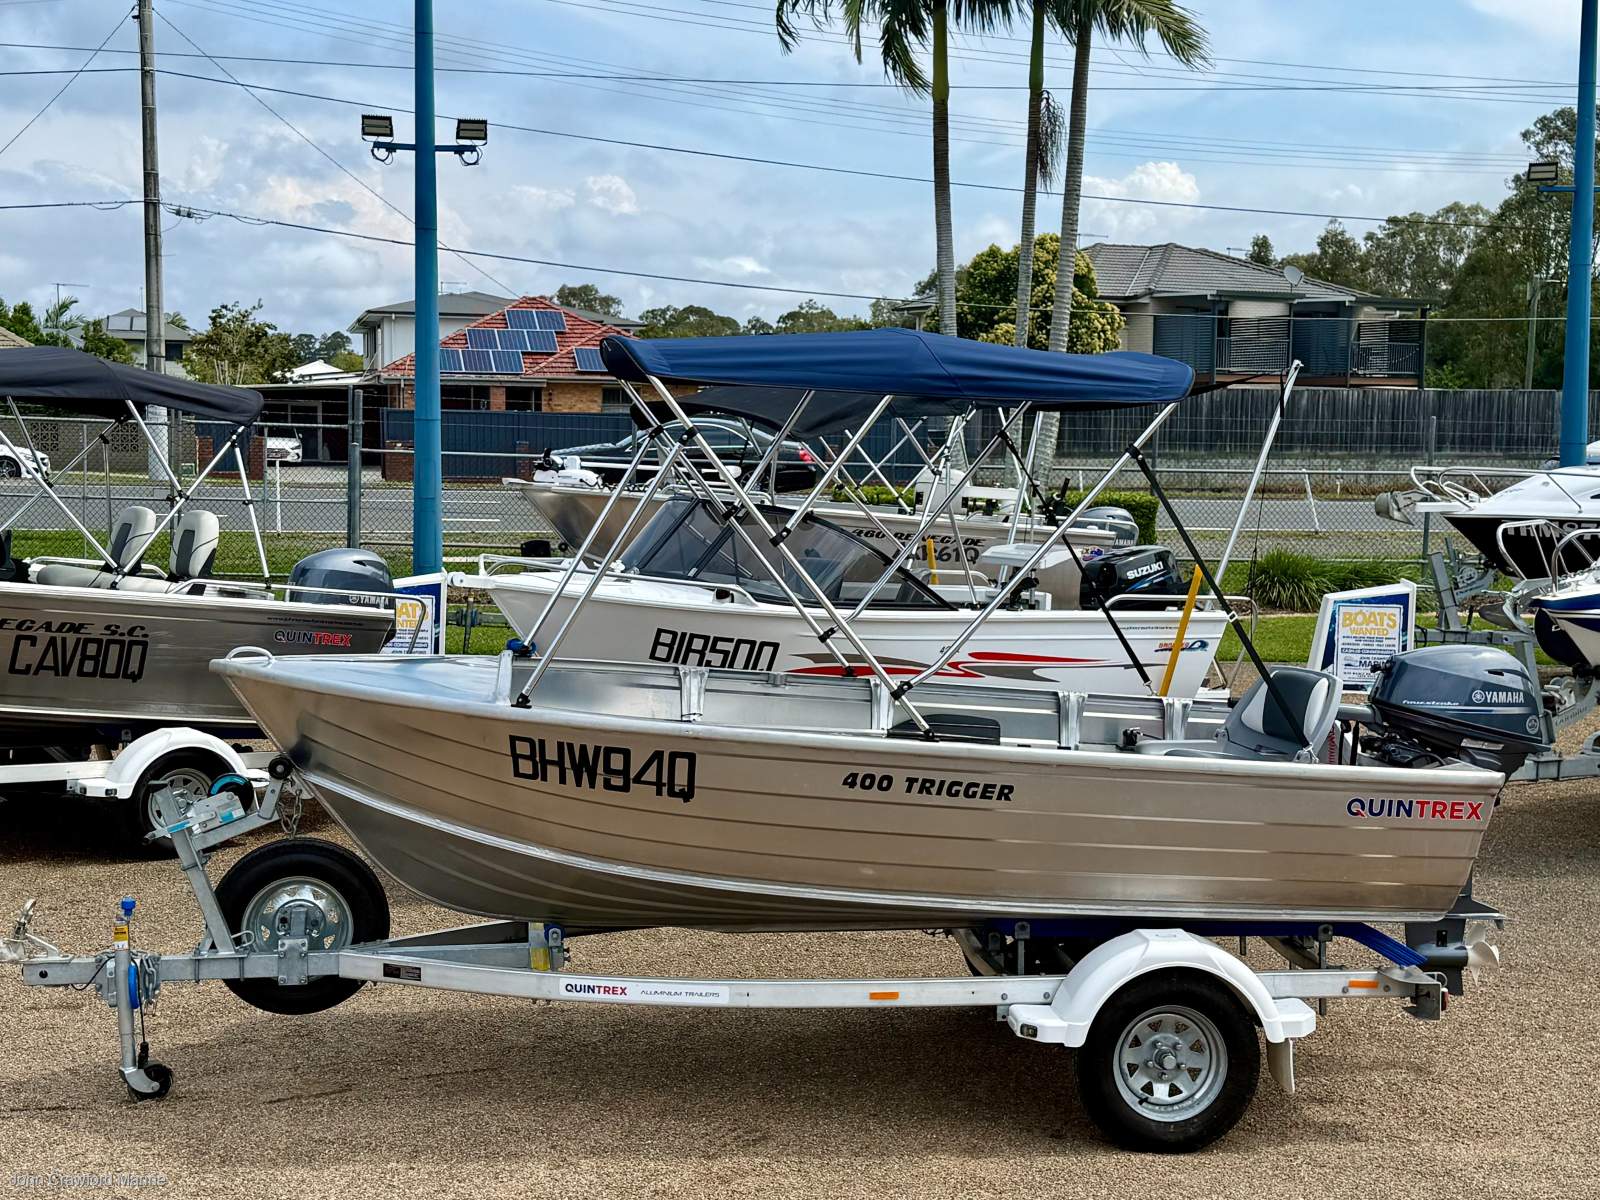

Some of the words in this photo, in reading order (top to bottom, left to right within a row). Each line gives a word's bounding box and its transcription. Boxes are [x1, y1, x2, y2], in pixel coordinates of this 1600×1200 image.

[1126, 561, 1164, 580] SUZUKI
[1342, 610, 1397, 629] BOATS
[100, 624, 149, 638] S.C.
[274, 630, 353, 647] QUINTREX
[1349, 627, 1389, 636] WANTED
[8, 634, 149, 683] CAV80Q
[1485, 691, 1525, 704] YAMAHA
[508, 734, 697, 803] BHW94Q
[842, 772, 894, 792] 400
[904, 776, 1015, 802] TRIGGER
[1346, 797, 1484, 820] QUINTREX
[565, 983, 628, 996] QUINTREX
